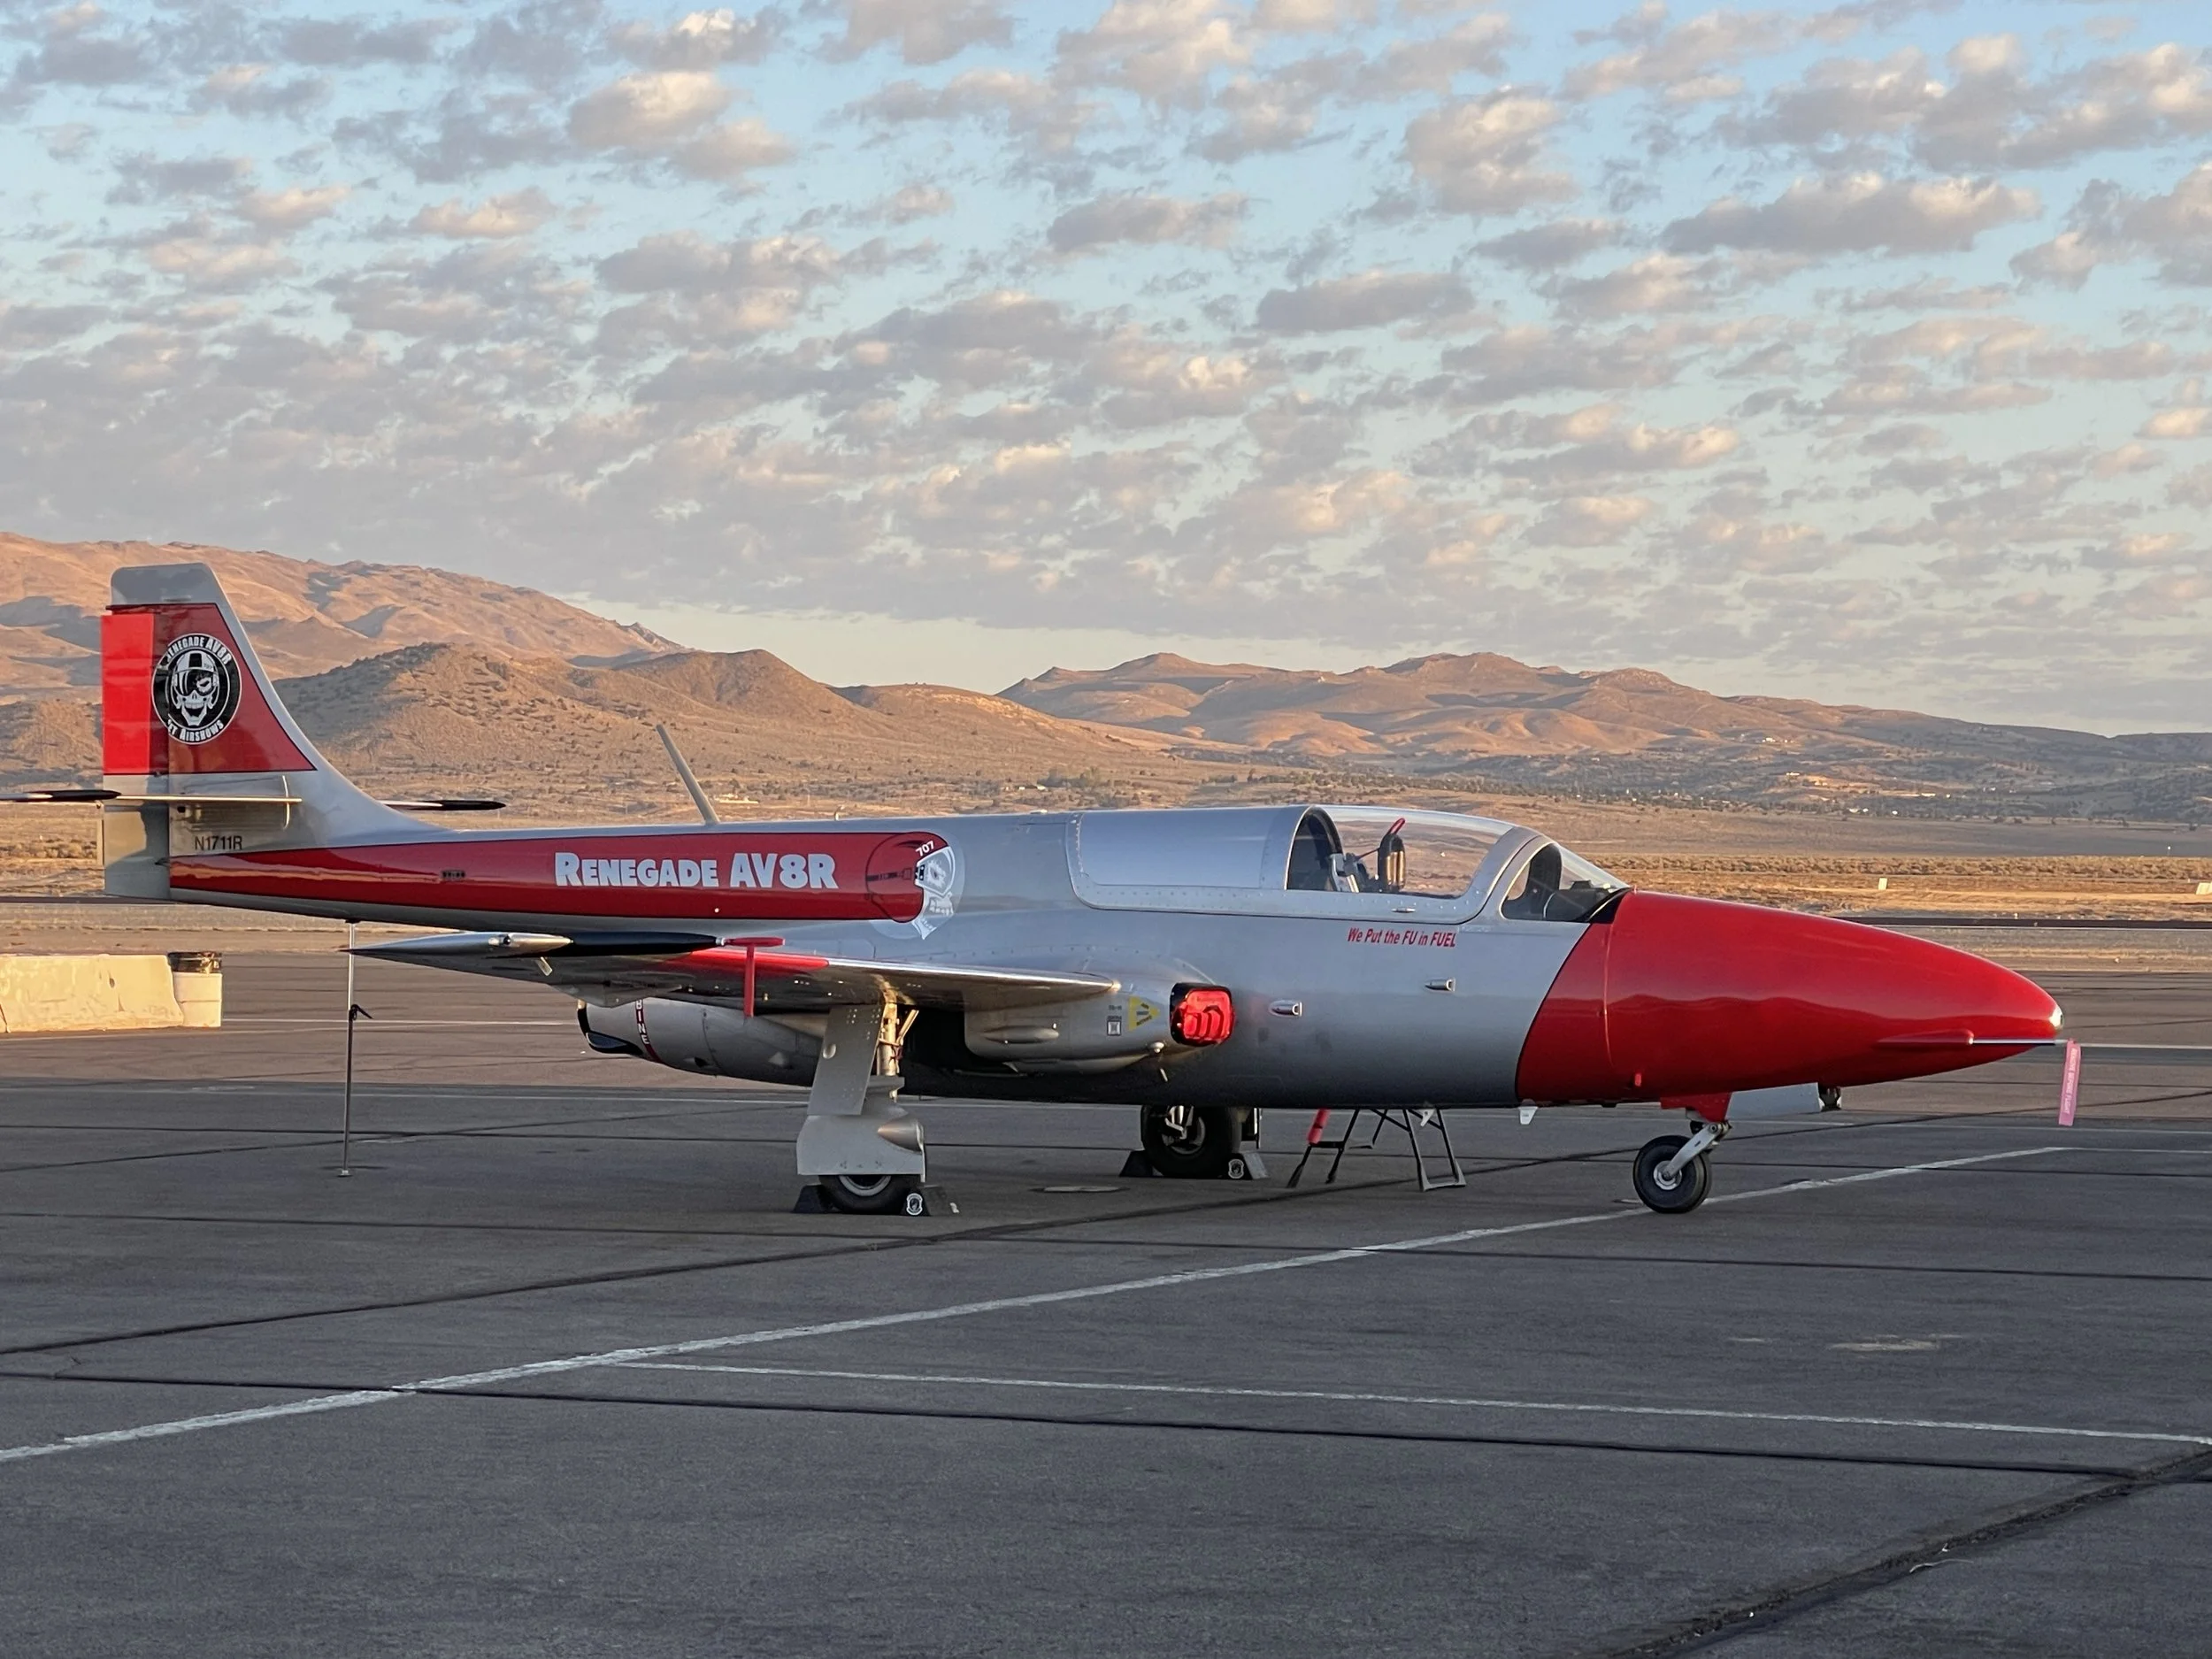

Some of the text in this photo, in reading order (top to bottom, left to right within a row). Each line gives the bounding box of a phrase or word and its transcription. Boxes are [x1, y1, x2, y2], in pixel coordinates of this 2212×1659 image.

[205, 637, 232, 664] AV8R
[180, 719, 224, 741] AIRSHOWS
[195, 835, 243, 850] N1711R
[915, 840, 935, 857] 707
[555, 852, 839, 889] RENEGADE AV8R
[1348, 927, 1456, 948] We Put the FU in FUEL
